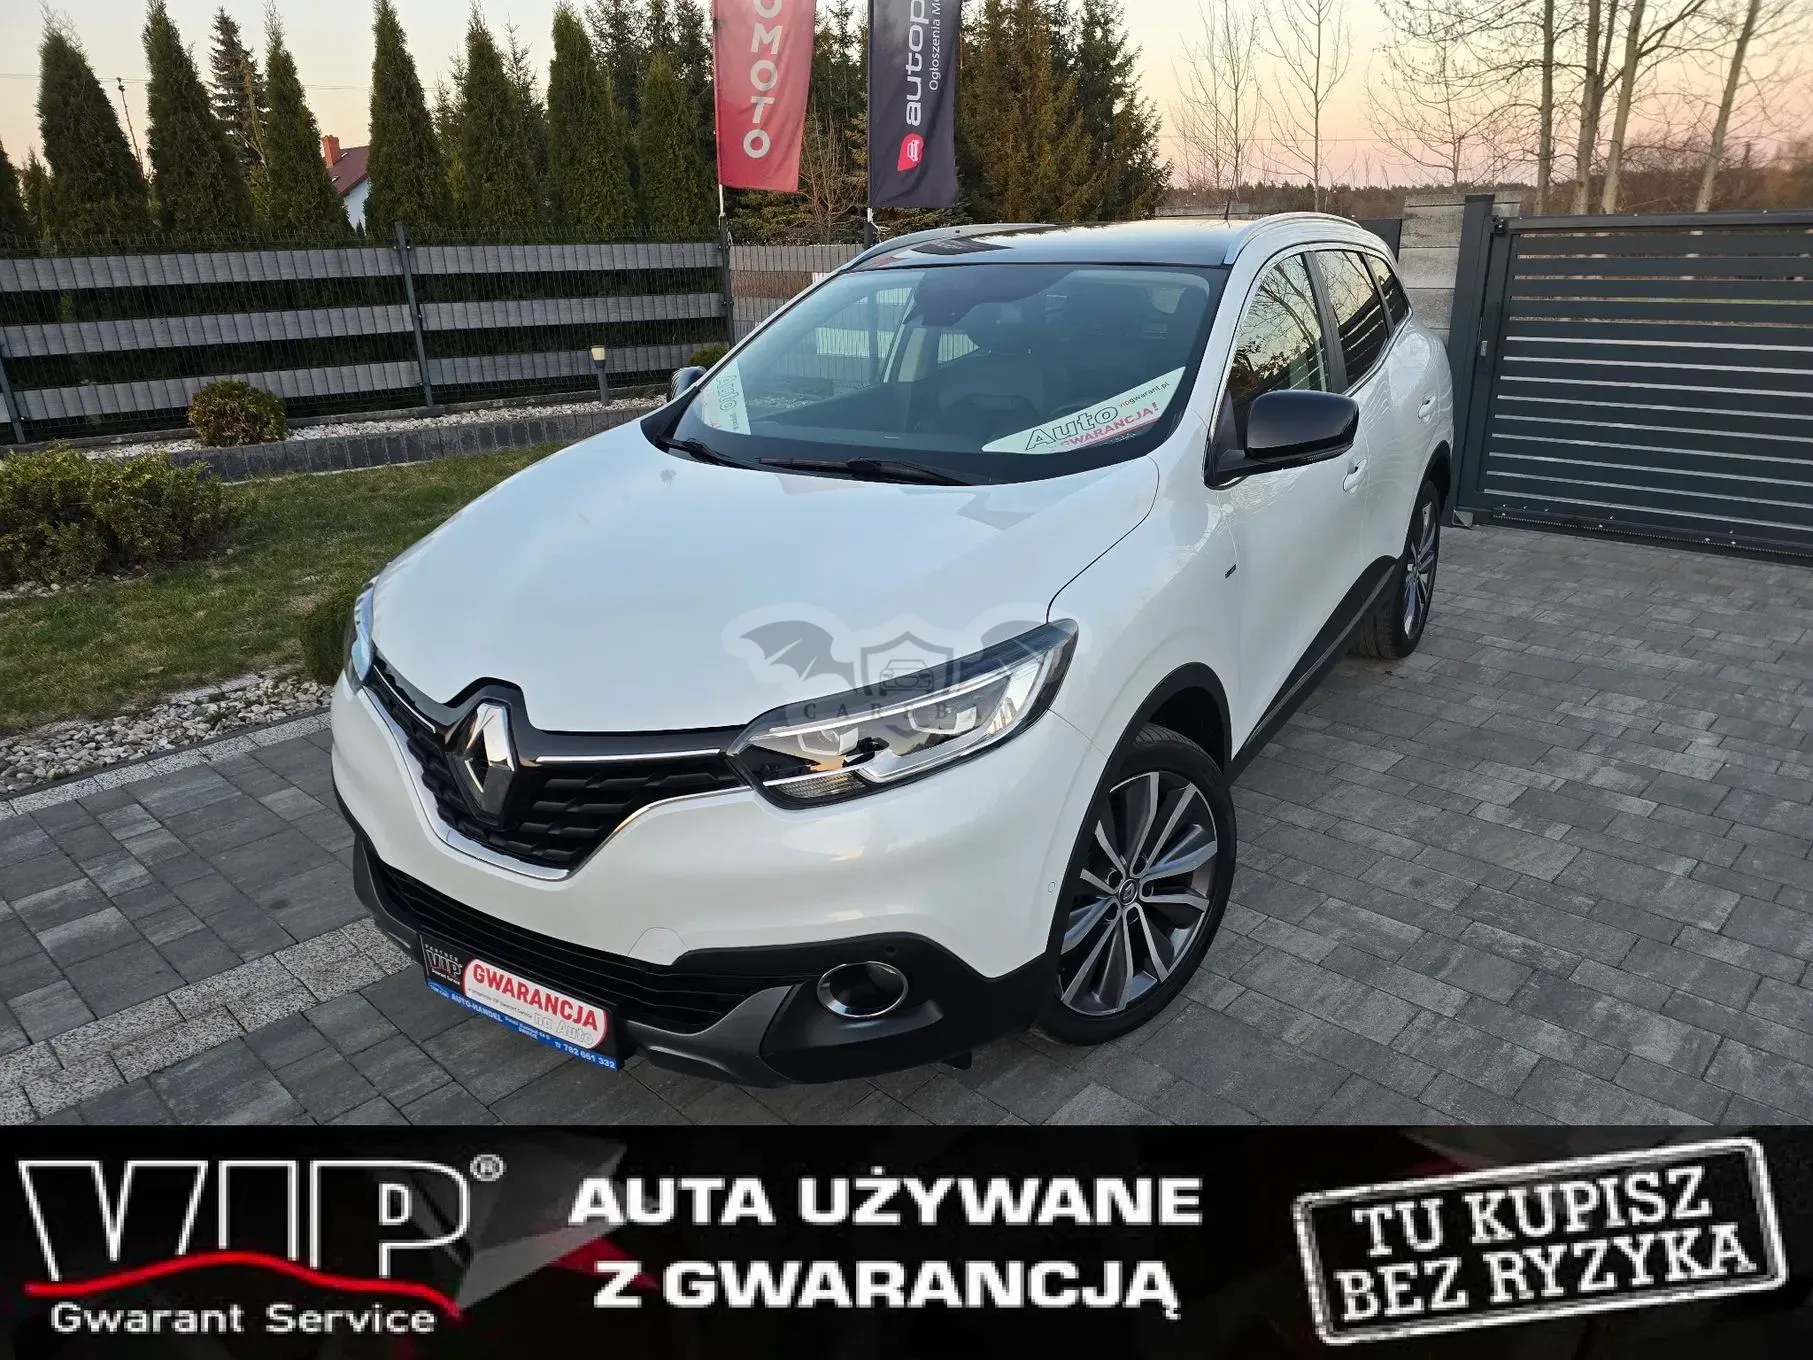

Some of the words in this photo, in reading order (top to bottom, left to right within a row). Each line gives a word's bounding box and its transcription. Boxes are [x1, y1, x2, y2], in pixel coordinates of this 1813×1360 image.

[931, 0, 941, 15] M
[929, 19, 941, 91] Ogłoszenia
[1025, 406, 1118, 451] Auto
[451, 993, 503, 1022] AUTO-HANDEL
[473, 963, 598, 1032] GWARANCJA
[534, 1012, 552, 1030] na
[556, 1020, 594, 1045] Auto
[599, 1057, 616, 1069] 332
